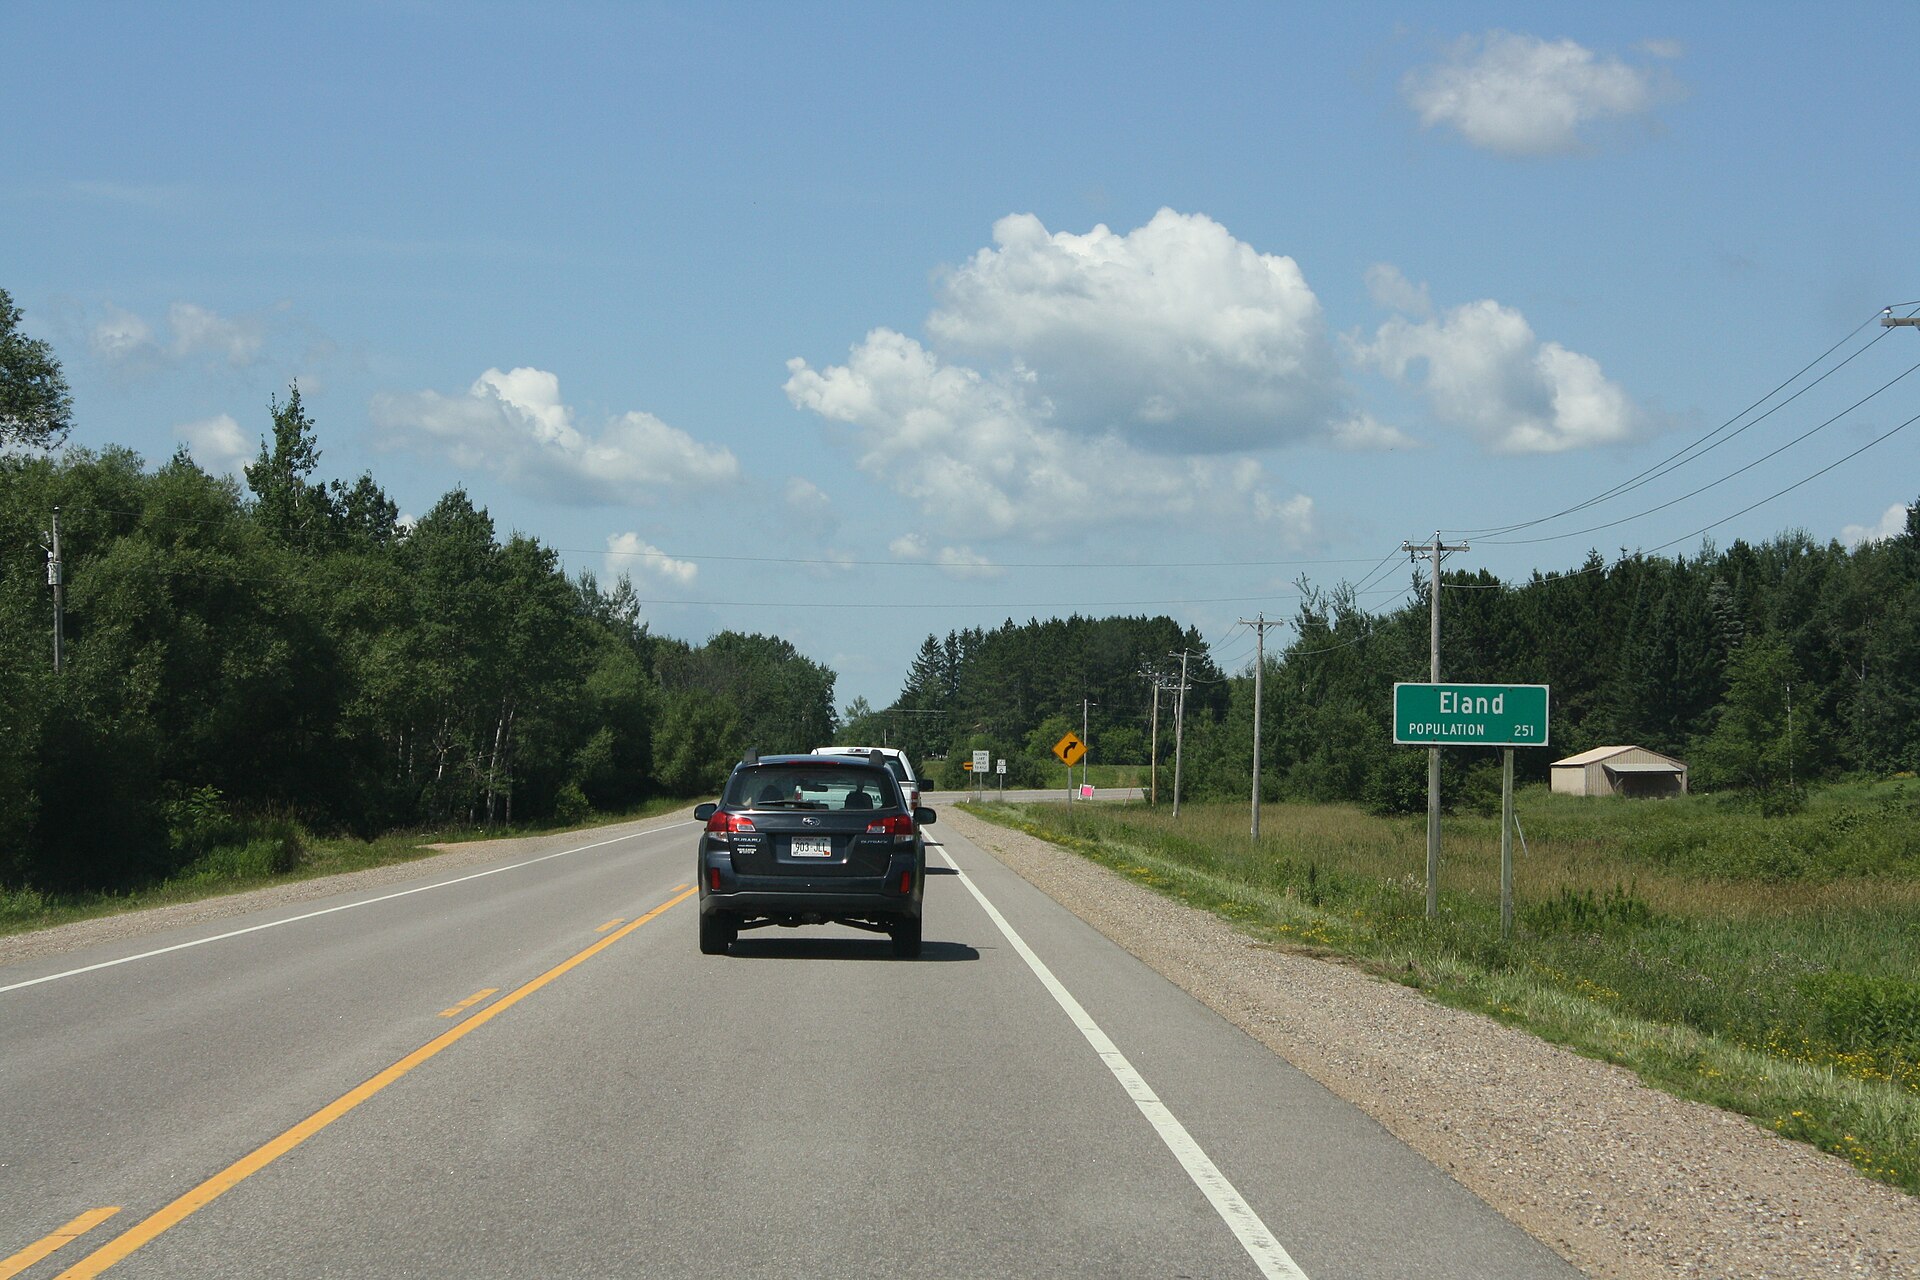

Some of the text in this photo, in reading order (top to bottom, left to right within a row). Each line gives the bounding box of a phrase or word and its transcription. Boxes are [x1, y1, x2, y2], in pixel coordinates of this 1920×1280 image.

[1439, 691, 1504, 715] Eland
[1409, 722, 1534, 737] POPULATION 251
